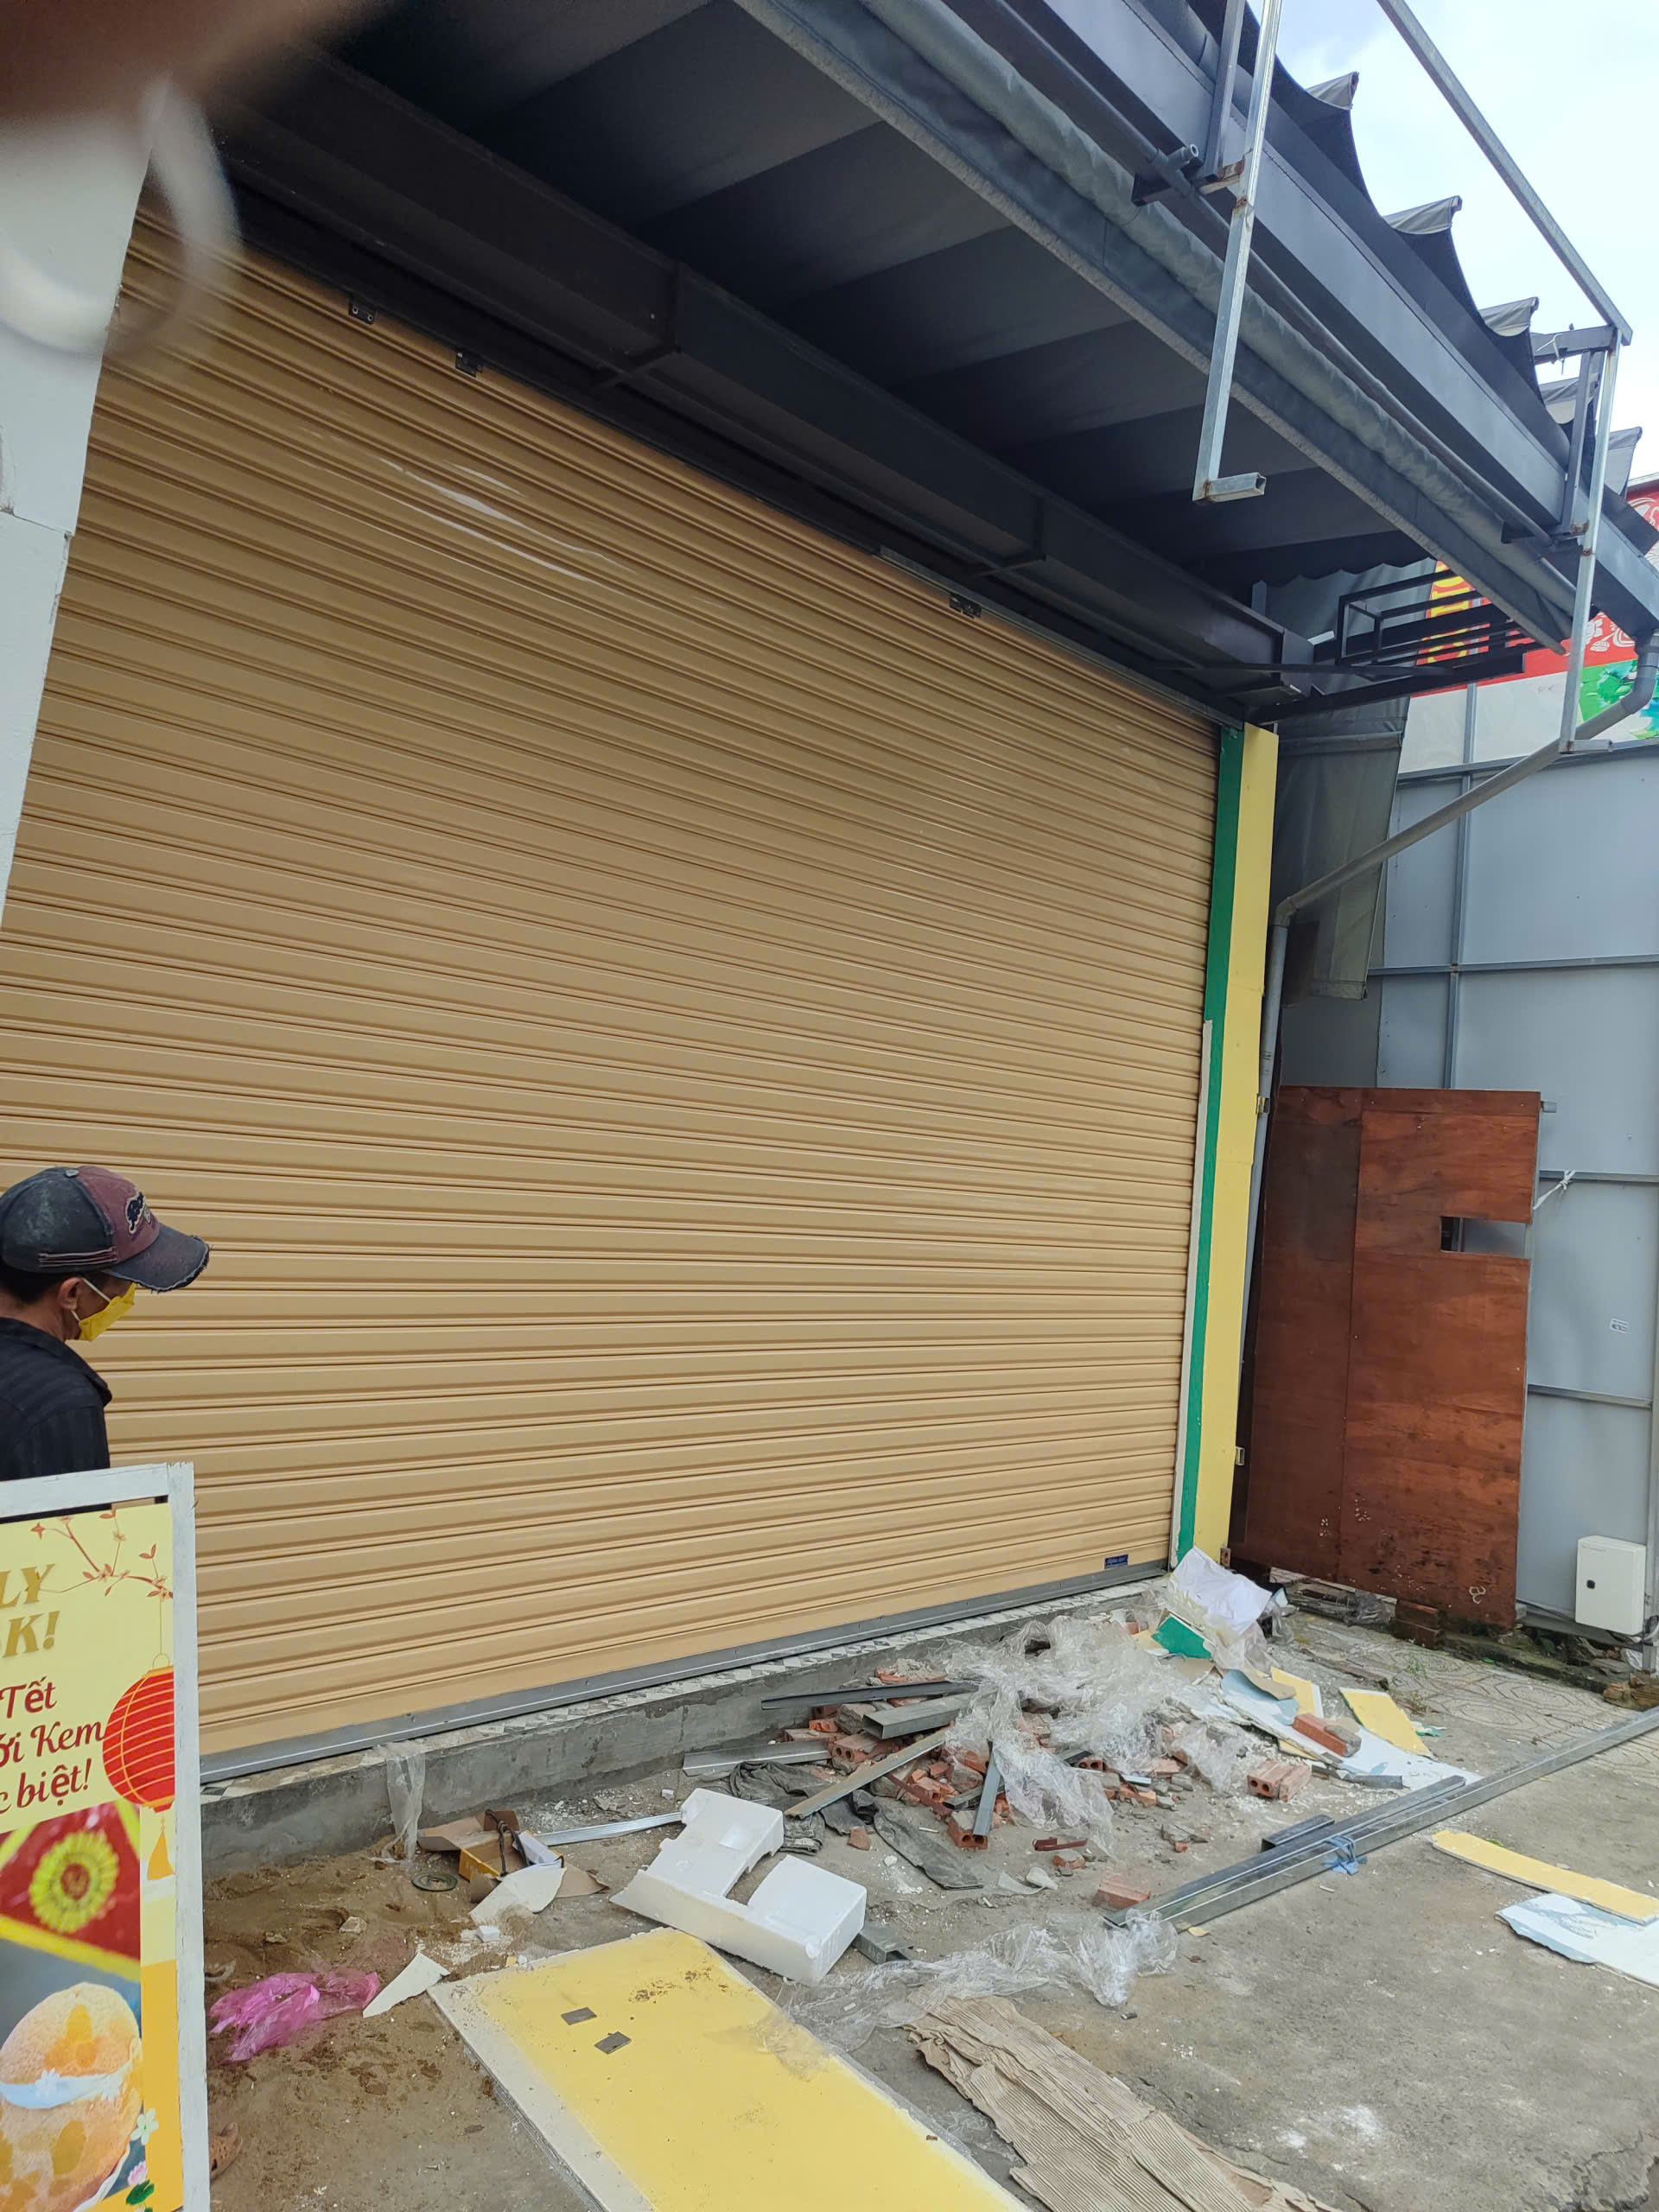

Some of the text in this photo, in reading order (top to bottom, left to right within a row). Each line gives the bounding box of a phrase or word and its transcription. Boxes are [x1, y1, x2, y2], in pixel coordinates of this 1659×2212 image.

[0, 1675, 57, 1719] Tết
[30, 1721, 105, 1757] Kem
[17, 1758, 92, 1806] biệt!
